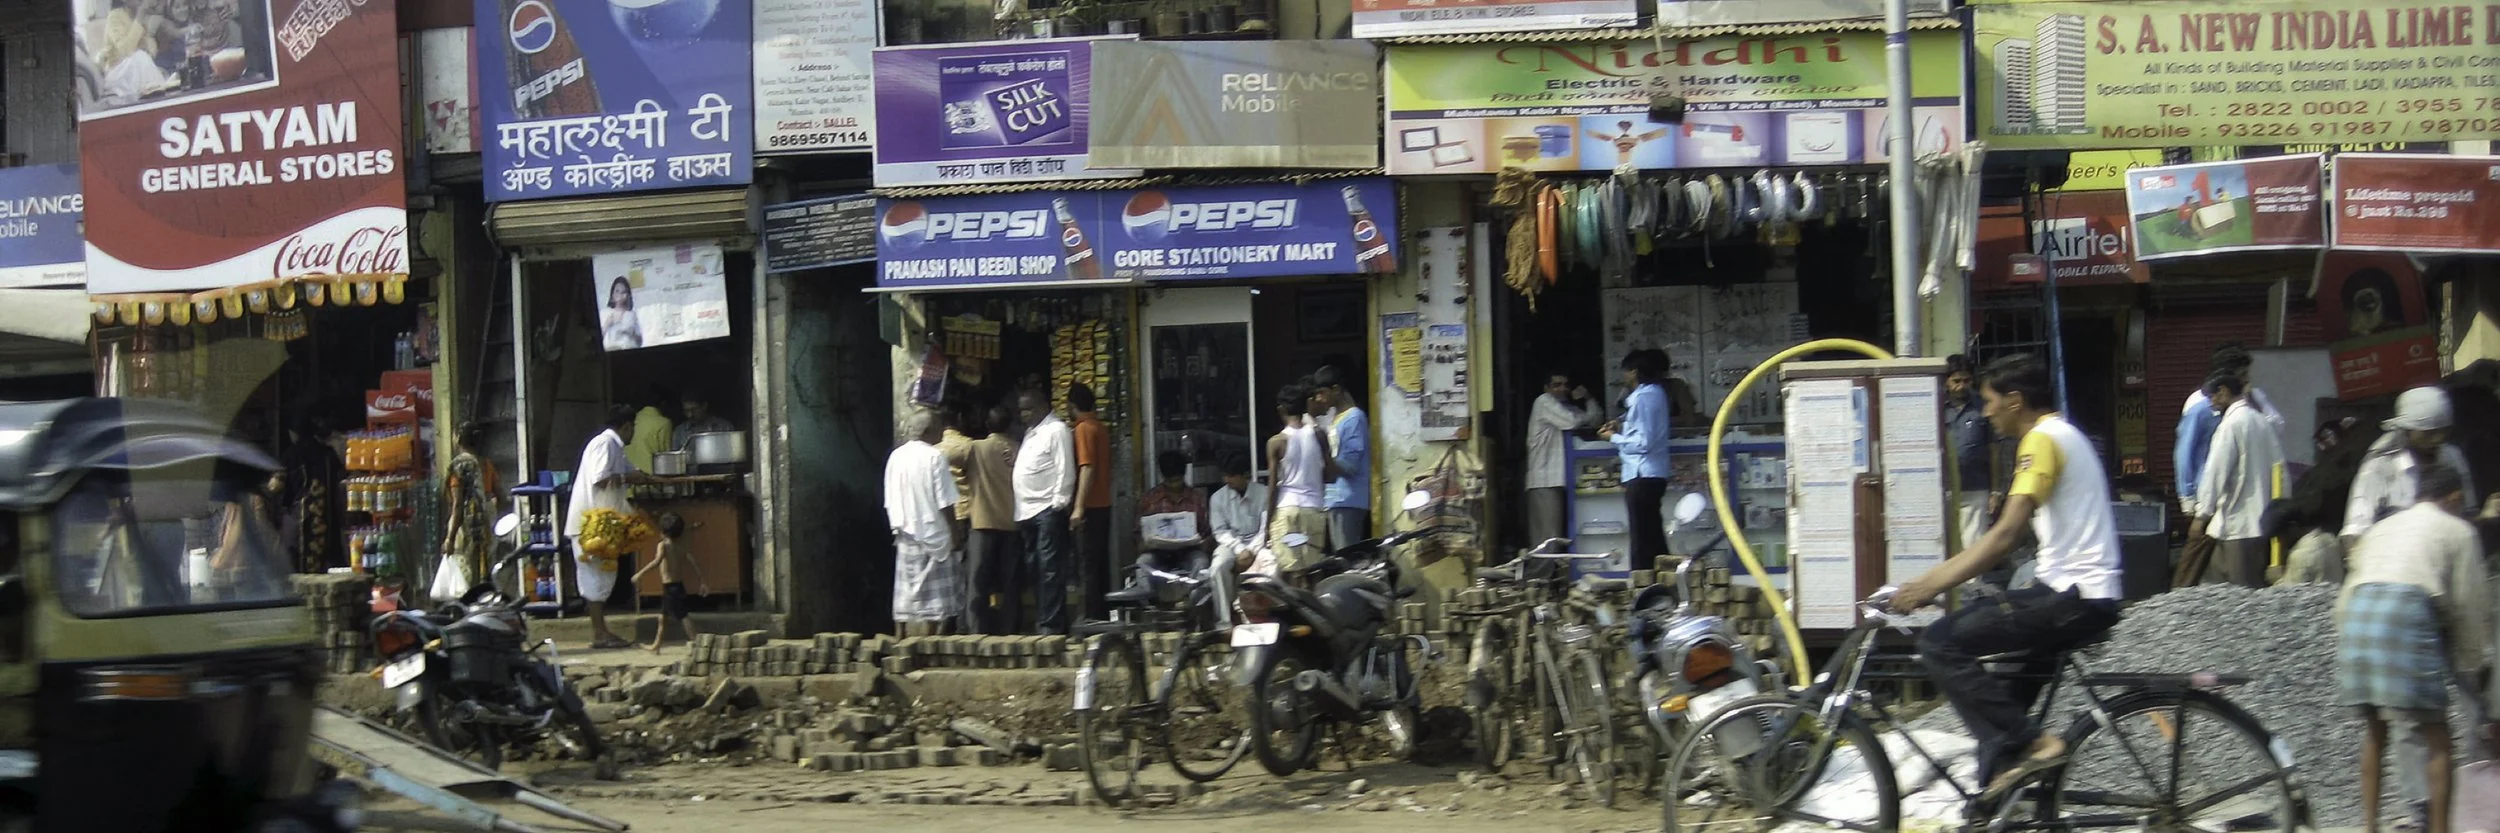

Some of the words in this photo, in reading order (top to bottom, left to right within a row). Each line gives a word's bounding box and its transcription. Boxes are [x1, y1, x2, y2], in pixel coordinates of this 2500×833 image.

[2096, 14, 2126, 55] S.
[2136, 14, 2169, 53] A.
[2180, 12, 2261, 52] NEW
[2271, 9, 2376, 50] INDIA
[2386, 6, 2473, 48] LIME
[1496, 37, 1850, 78] Niddhi
[2143, 62, 2161, 74] All
[2164, 61, 2203, 73] Kinds
[2208, 61, 2223, 73] of
[2226, 60, 2284, 75] Building
[2288, 59, 2349, 71] Material
[2353, 57, 2413, 72] Supplier
[2417, 56, 2427, 69] &
[2432, 56, 2465, 68] Civil
[514, 57, 585, 108] PEPSI
[1545, 77, 1642, 90] Electric
[1680, 74, 1802, 87] Hardware
[2096, 82, 2162, 96] Specialist
[997, 82, 1054, 111] SILK
[1221, 94, 1303, 113] Mobile
[2158, 103, 2199, 118] Tel.
[2227, 102, 2293, 117] 2822
[2303, 100, 2369, 116] 0002
[2397, 98, 2463, 114] 3955
[497, 99, 668, 160] महालक्ष्मी
[688, 92, 732, 142] टी
[1007, 98, 1062, 132] CUT
[160, 101, 357, 159] SATYAM
[769, 131, 868, 147] 9869567114
[2102, 123, 2191, 139] Mobile
[2217, 122, 2300, 138] 93226
[2310, 120, 2393, 136] 91987
[142, 160, 273, 194] GENERAL
[280, 149, 394, 183] STORES
[667, 153, 732, 181] हाऊस
[979, 162, 1007, 177] पान
[2067, 163, 2117, 179] eer's
[2345, 188, 2412, 201] Lifetime
[2413, 189, 2475, 204] prepaid
[1169, 199, 1298, 231] PEPSI
[2357, 204, 2392, 219] just
[925, 209, 1049, 241] PEPSI
[2038, 226, 2127, 258] Airtel
[885, 258, 947, 280] PRAKASH
[950, 257, 976, 277] PAN
[979, 256, 1017, 277] BEEDI
[1020, 255, 1057, 275] SHOP
[1114, 248, 1165, 268] GORE
[1168, 245, 1280, 266] STATIONERY
[1285, 242, 1337, 261] MART
[2055, 265, 2089, 278] OBILE
